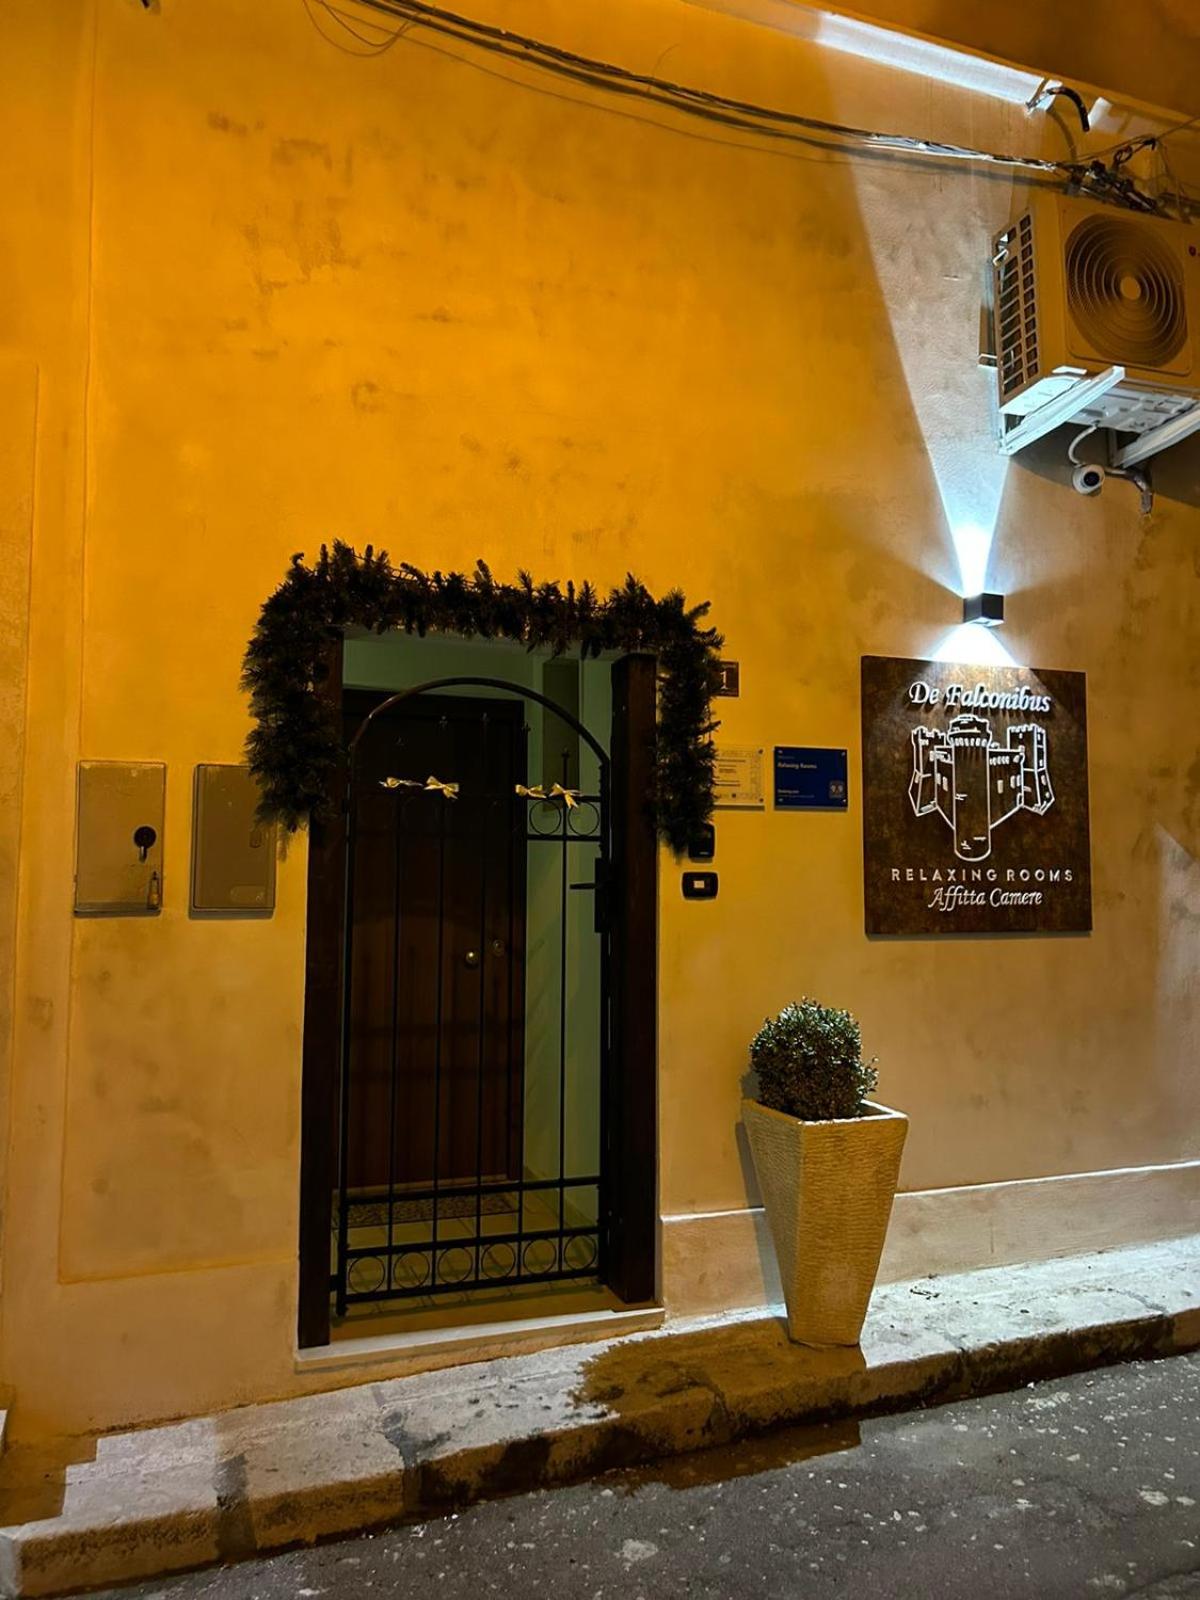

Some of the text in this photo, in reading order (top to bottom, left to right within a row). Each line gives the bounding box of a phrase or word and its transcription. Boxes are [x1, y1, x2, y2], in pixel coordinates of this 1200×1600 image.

[908, 681, 1052, 712] De Falconibus
[891, 868, 1073, 882] RELAXING ROOMS
[927, 884, 1043, 912] Affitta Camere
